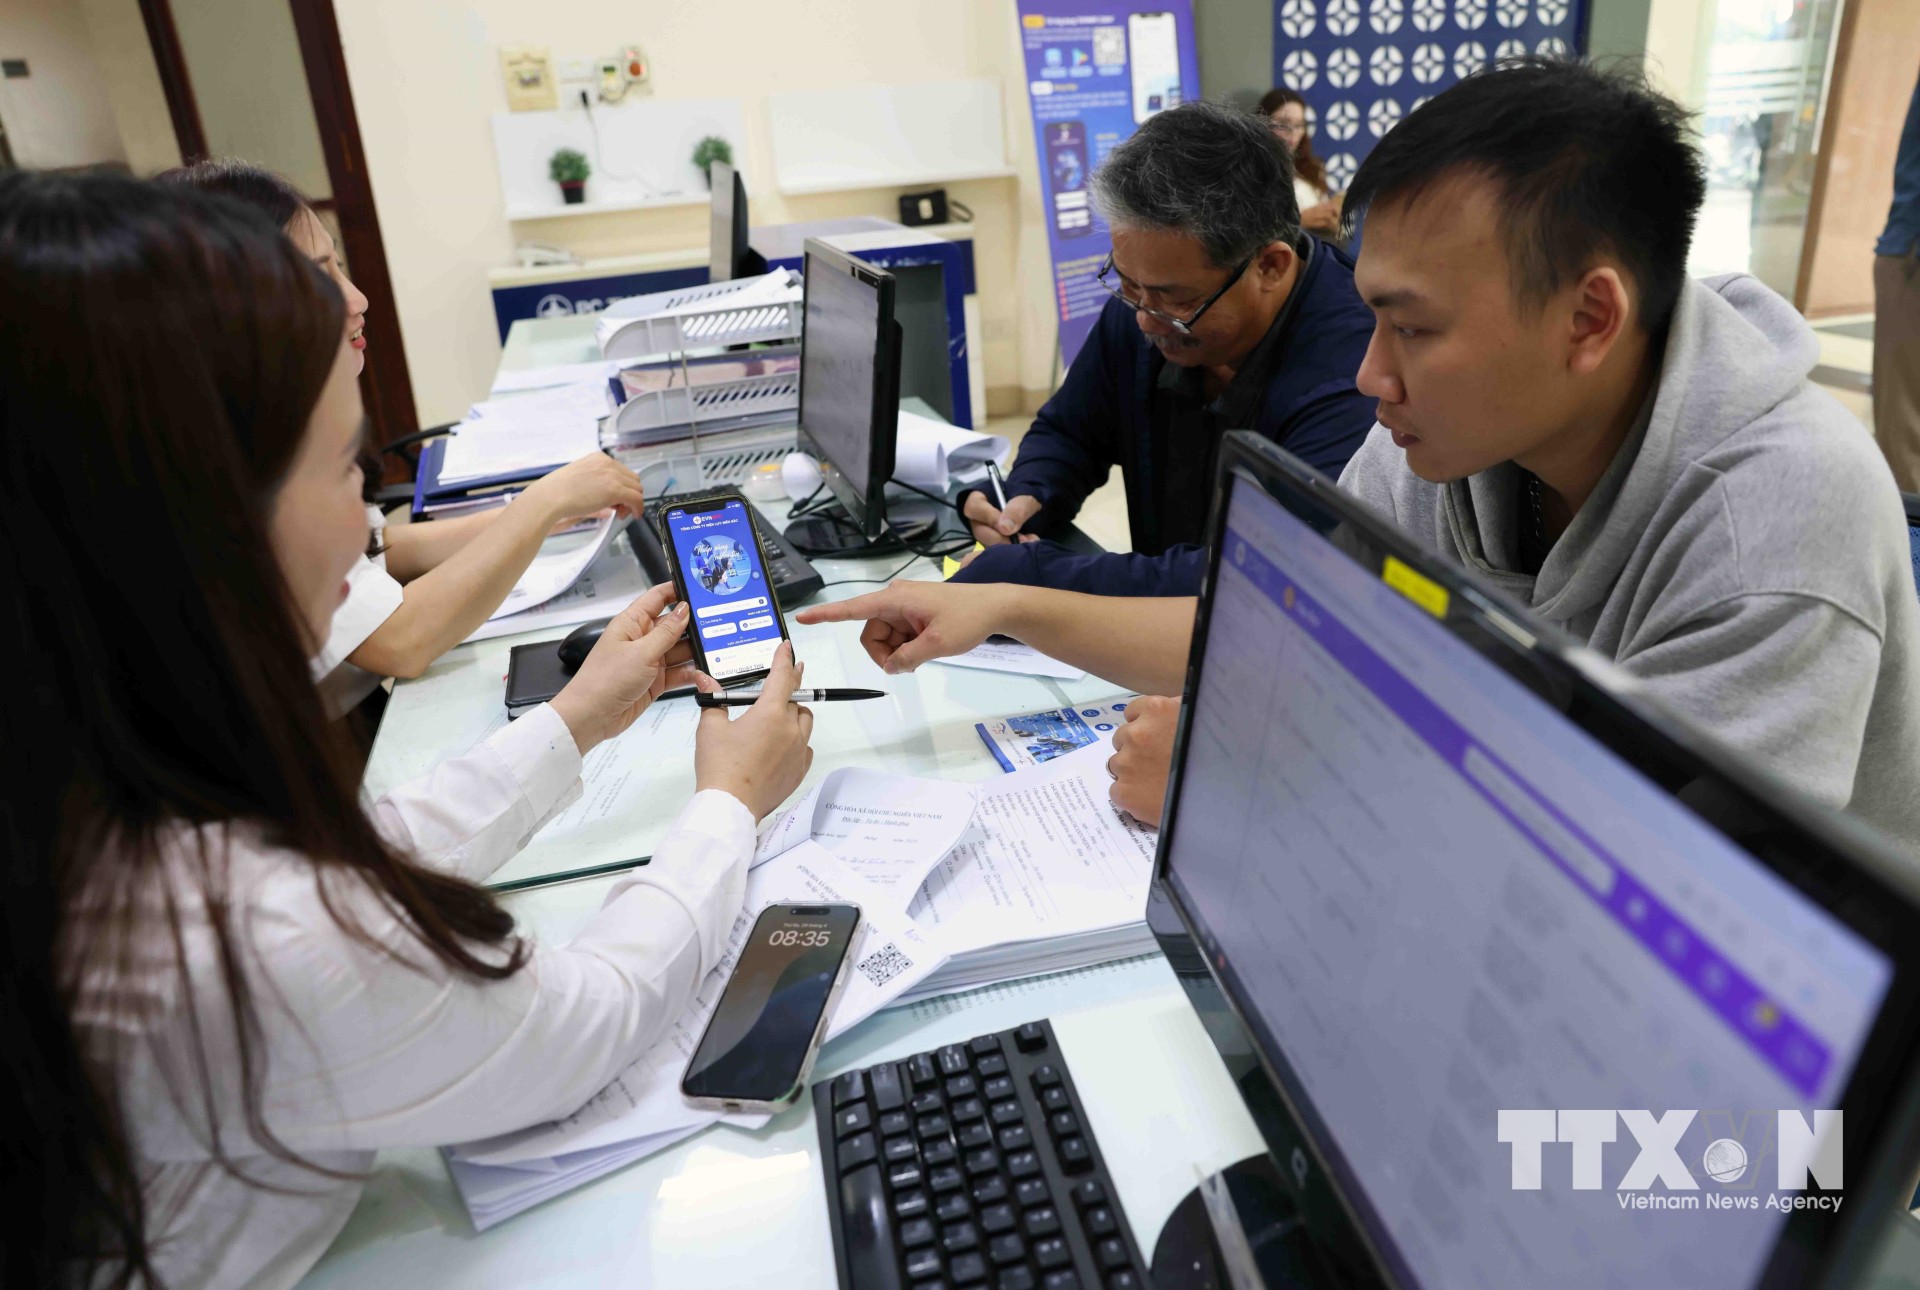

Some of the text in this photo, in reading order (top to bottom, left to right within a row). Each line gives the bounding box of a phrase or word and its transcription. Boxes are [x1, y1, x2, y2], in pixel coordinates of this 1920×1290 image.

[844, 804, 857, 813] HÒA
[858, 806, 867, 814] XÃ
[893, 810, 912, 818] NGHĨA
[912, 811, 926, 819] VIỆT
[768, 930, 832, 947] 08:35
